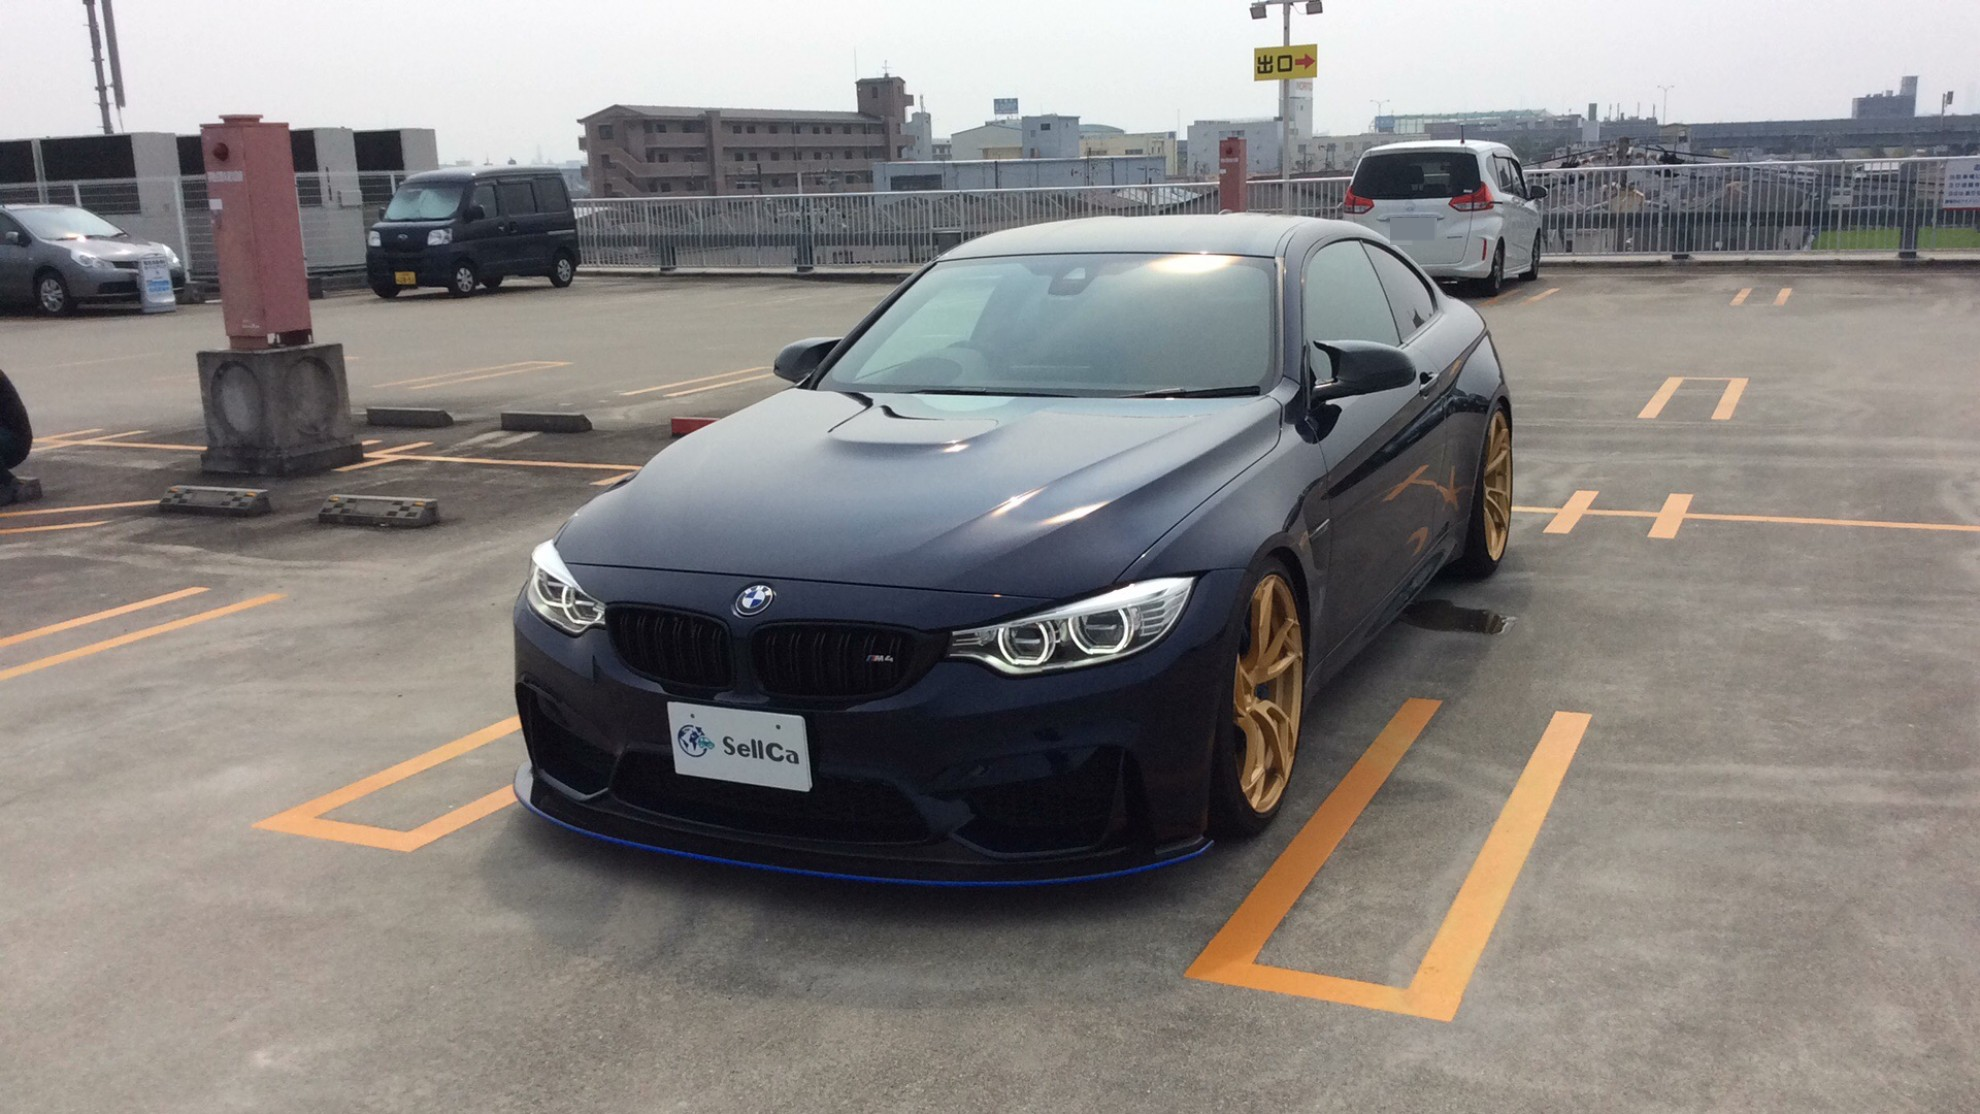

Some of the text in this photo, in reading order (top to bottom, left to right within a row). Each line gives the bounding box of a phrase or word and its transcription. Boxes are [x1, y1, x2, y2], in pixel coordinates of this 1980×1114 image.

[1257, 54, 1293, 74] 出口
[868, 654, 894, 663] M4
[722, 735, 800, 765] SellCa
